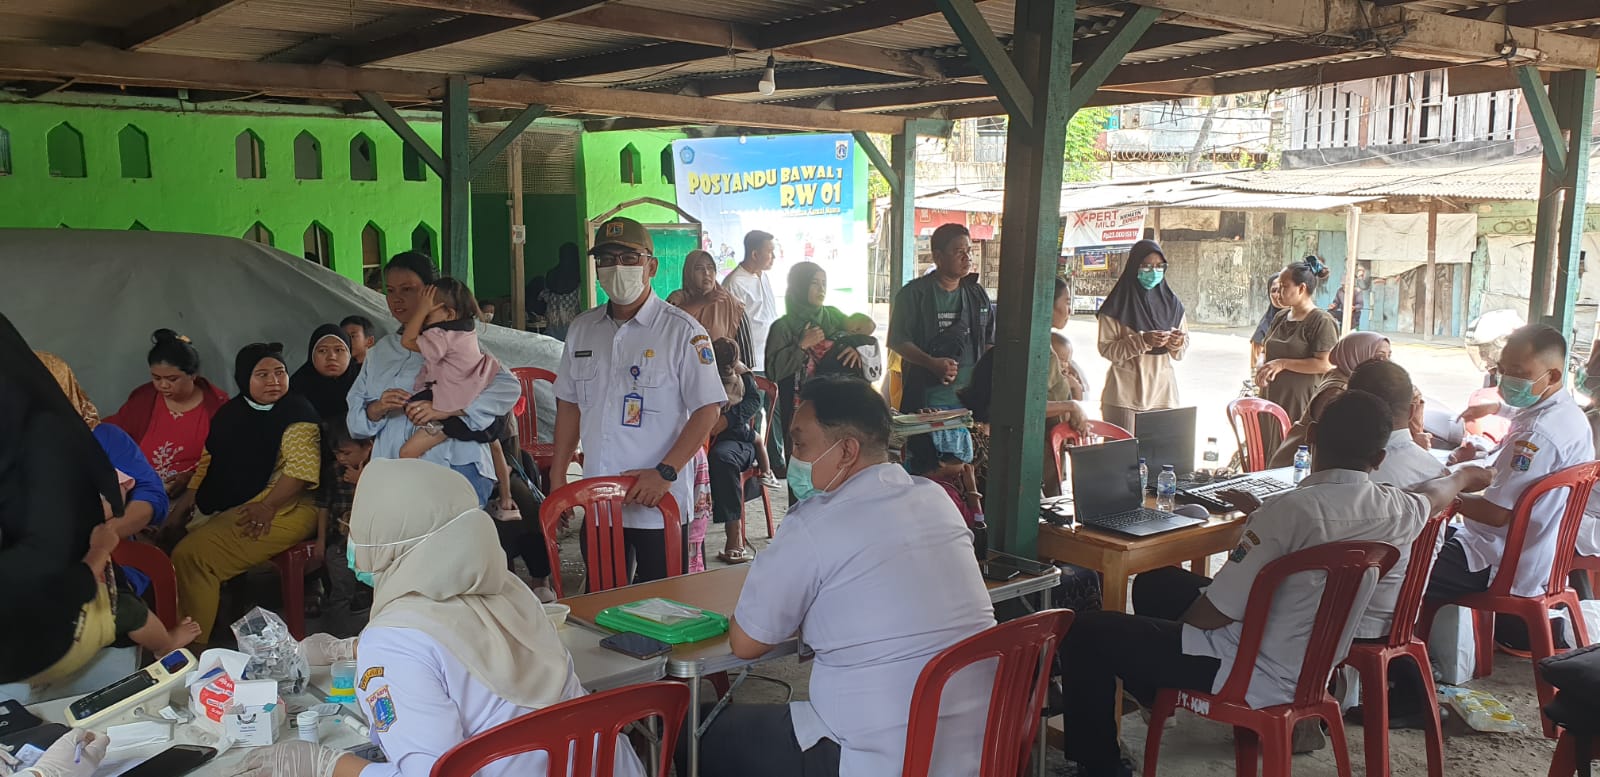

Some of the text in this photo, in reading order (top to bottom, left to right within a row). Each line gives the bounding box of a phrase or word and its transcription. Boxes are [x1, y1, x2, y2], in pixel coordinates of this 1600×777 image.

[688, 168, 777, 195] POSYANDU
[780, 165, 835, 184] BAWAL
[780, 181, 842, 208] RW 01
[1073, 210, 1118, 228] X-PERT
[1095, 220, 1116, 228] MILD
